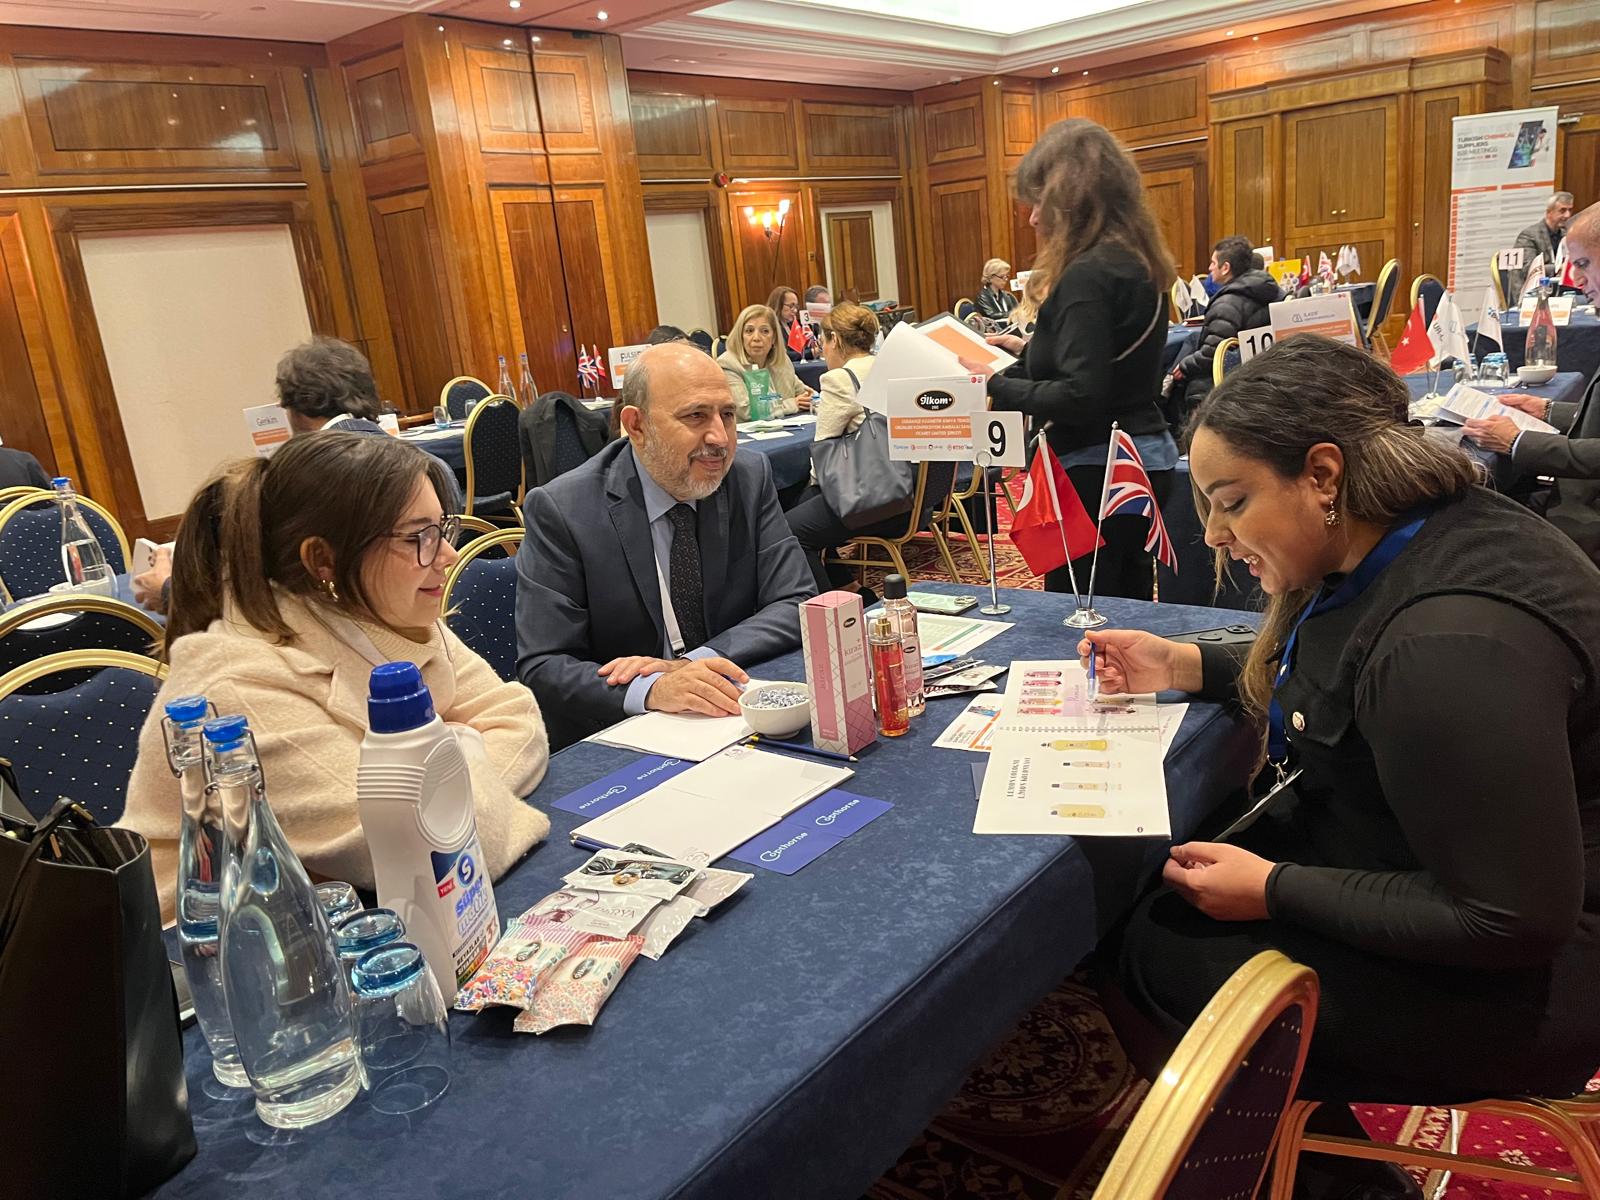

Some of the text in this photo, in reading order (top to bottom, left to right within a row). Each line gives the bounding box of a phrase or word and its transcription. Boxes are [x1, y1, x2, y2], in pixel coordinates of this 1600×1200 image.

[1504, 252, 1519, 266] 11
[1246, 332, 1274, 356] 10
[988, 420, 1006, 457] 9
[637, 758, 681, 780] Copthorne
[578, 785, 627, 810] Copthorne
[816, 799, 860, 826] Copthorne
[759, 832, 808, 862] Copthorne
[461, 857, 472, 881] S
